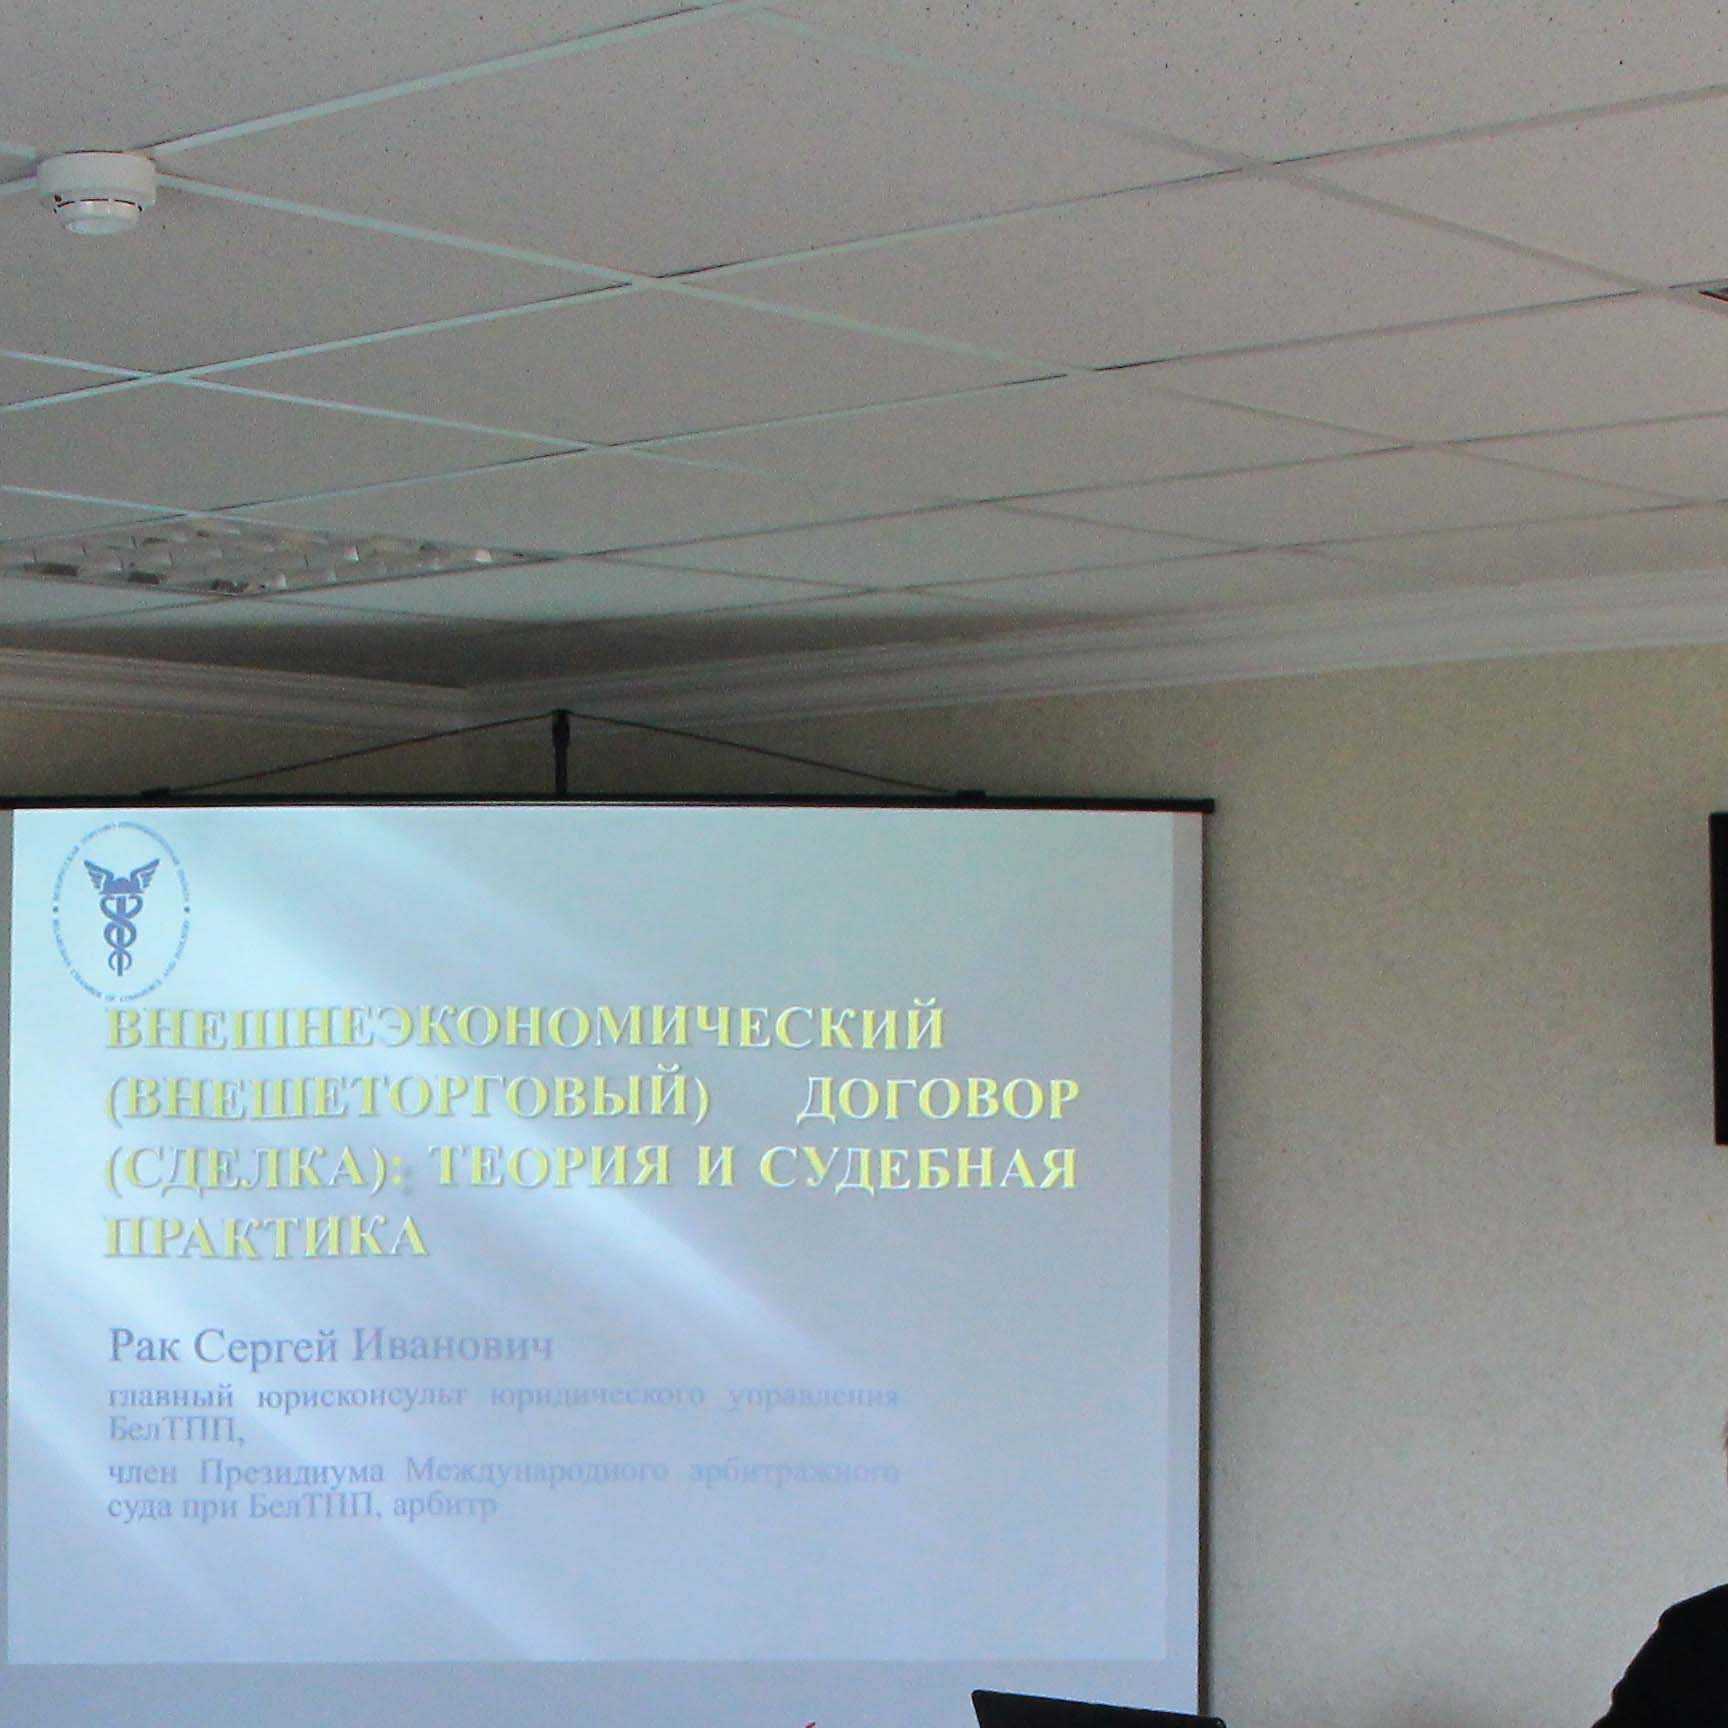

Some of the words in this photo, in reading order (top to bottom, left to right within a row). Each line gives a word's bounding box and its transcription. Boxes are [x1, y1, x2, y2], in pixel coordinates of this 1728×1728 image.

[105, 997, 945, 1051] ВНЕШНЕЭКОНОМИЧЕСКИЙ
[105, 1063, 710, 1128] (ВНЕШЕТОРГОВЫЙ)
[796, 1076, 1081, 1126] ДОГОВОР
[105, 1146, 405, 1198] (СДЕЛКА):
[429, 1145, 672, 1188] ТЕОРИЯ
[697, 1145, 735, 1187] И
[759, 1146, 1078, 1197] СУДЕБНАЯ
[104, 1214, 429, 1260] ПРАКТИКА
[109, 1328, 181, 1363] Рак
[193, 1328, 338, 1373] Сергей
[353, 1326, 554, 1363] Иванович
[108, 1384, 235, 1409] главный
[256, 1387, 469, 1416] юрисконсульт
[490, 1386, 705, 1415] юридического
[727, 1387, 901, 1414] управления
[108, 1415, 246, 1447] БелТПП,
[108, 1465, 178, 1486] член
[200, 1457, 385, 1491] Президиума
[405, 1455, 669, 1491] Международного
[688, 1455, 901, 1489] арбитражного
[107, 1497, 173, 1525] суда
[181, 1498, 238, 1525] при
[392, 1489, 498, 1524] арбитр
